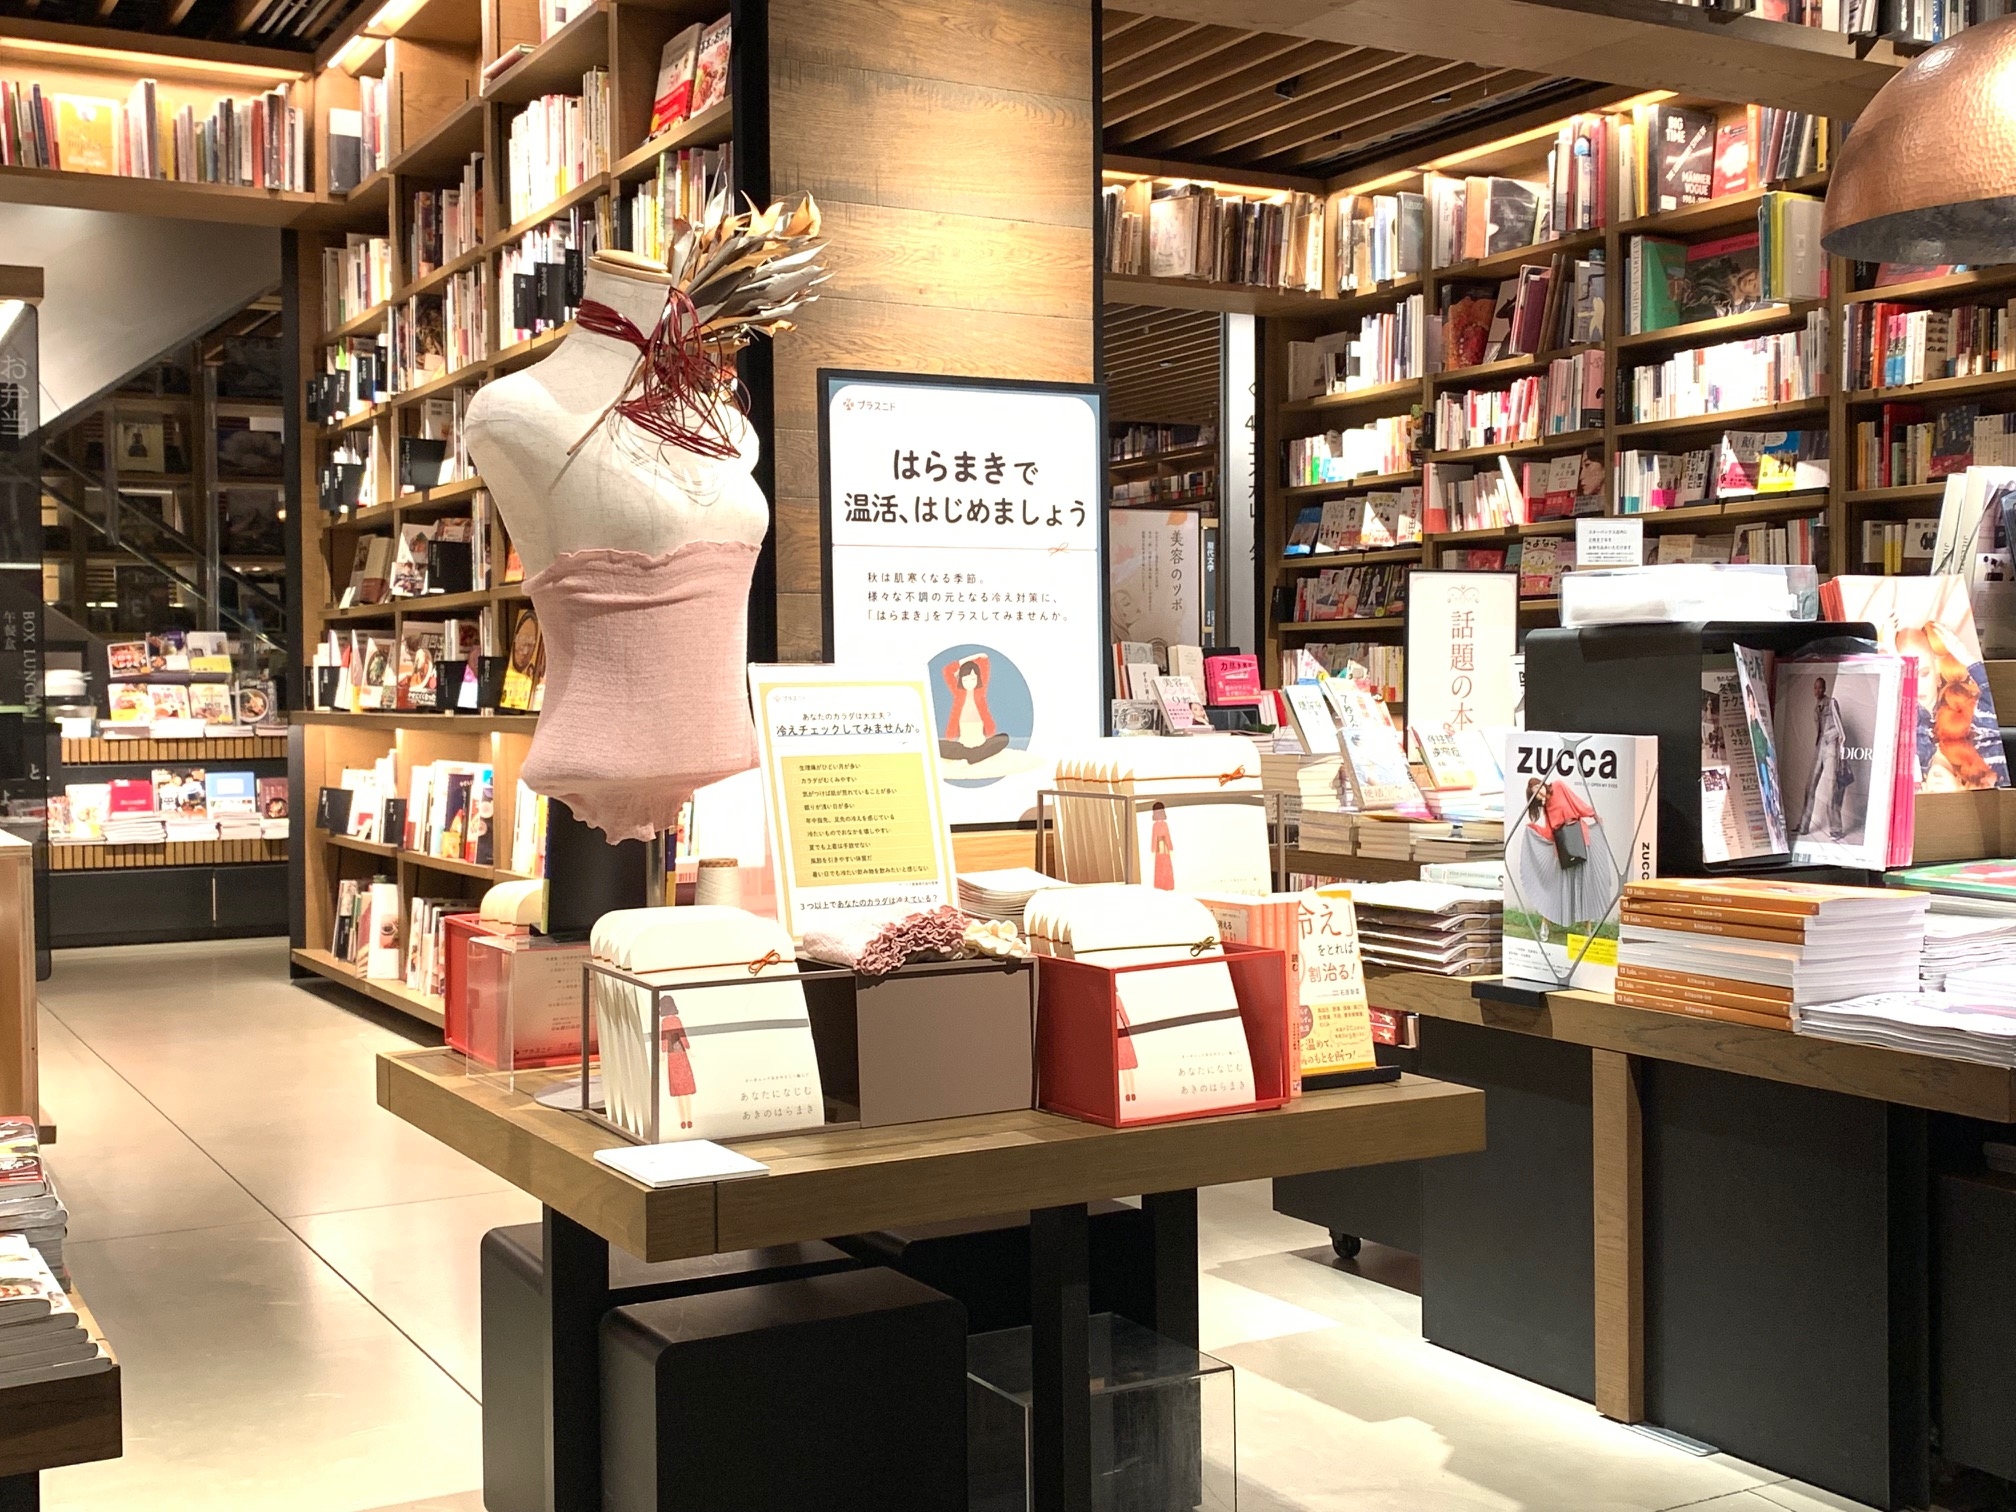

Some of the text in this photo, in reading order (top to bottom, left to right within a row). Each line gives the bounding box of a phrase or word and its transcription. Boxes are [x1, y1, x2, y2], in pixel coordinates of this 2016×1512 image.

[1667, 116, 1683, 130] BIG
[1665, 128, 1686, 143] TIME
[1684, 183, 1709, 196] VOGUE
[893, 449, 1039, 486] はらまきで
[844, 492, 1087, 528] 温活、はじめましょう
[1523, 539, 1559, 550] さよなら
[1206, 541, 1215, 572] 現代文学
[1170, 530, 1184, 611] 美容のツボ
[867, 572, 984, 584] 秋は肌寒くなる季節。
[867, 591, 1059, 604] 様々な不調の元となる冷え対策に、
[867, 610, 1069, 622] 「はらまき」をプラスしてみませんか。
[22, 611, 37, 707] BOX LUNCH
[1450, 611, 1475, 732] 話題の本
[802, 711, 891, 721] あなたのカラダは大丈夫？
[776, 723, 920, 737] 冷えチェックしてみませんか。
[1841, 747, 1873, 761] DIOR
[1516, 745, 1618, 780] zucca
[800, 894, 938, 911] 3つ以上であなたのカラダは冷えている？
[1701, 895, 1732, 904] kitsune-iro
[1693, 909, 1723, 918] kitsune-iro
[1693, 923, 1723, 932] kitsune-iro
[1317, 941, 1354, 956] をとれば
[1307, 963, 1356, 984] 割治る！
[1178, 1063, 1243, 1077] あなたになじむ
[740, 1086, 812, 1102] あなたになじむ
[1180, 1081, 1245, 1095] あきのはらまき
[742, 1104, 814, 1120] あきのはらまき
